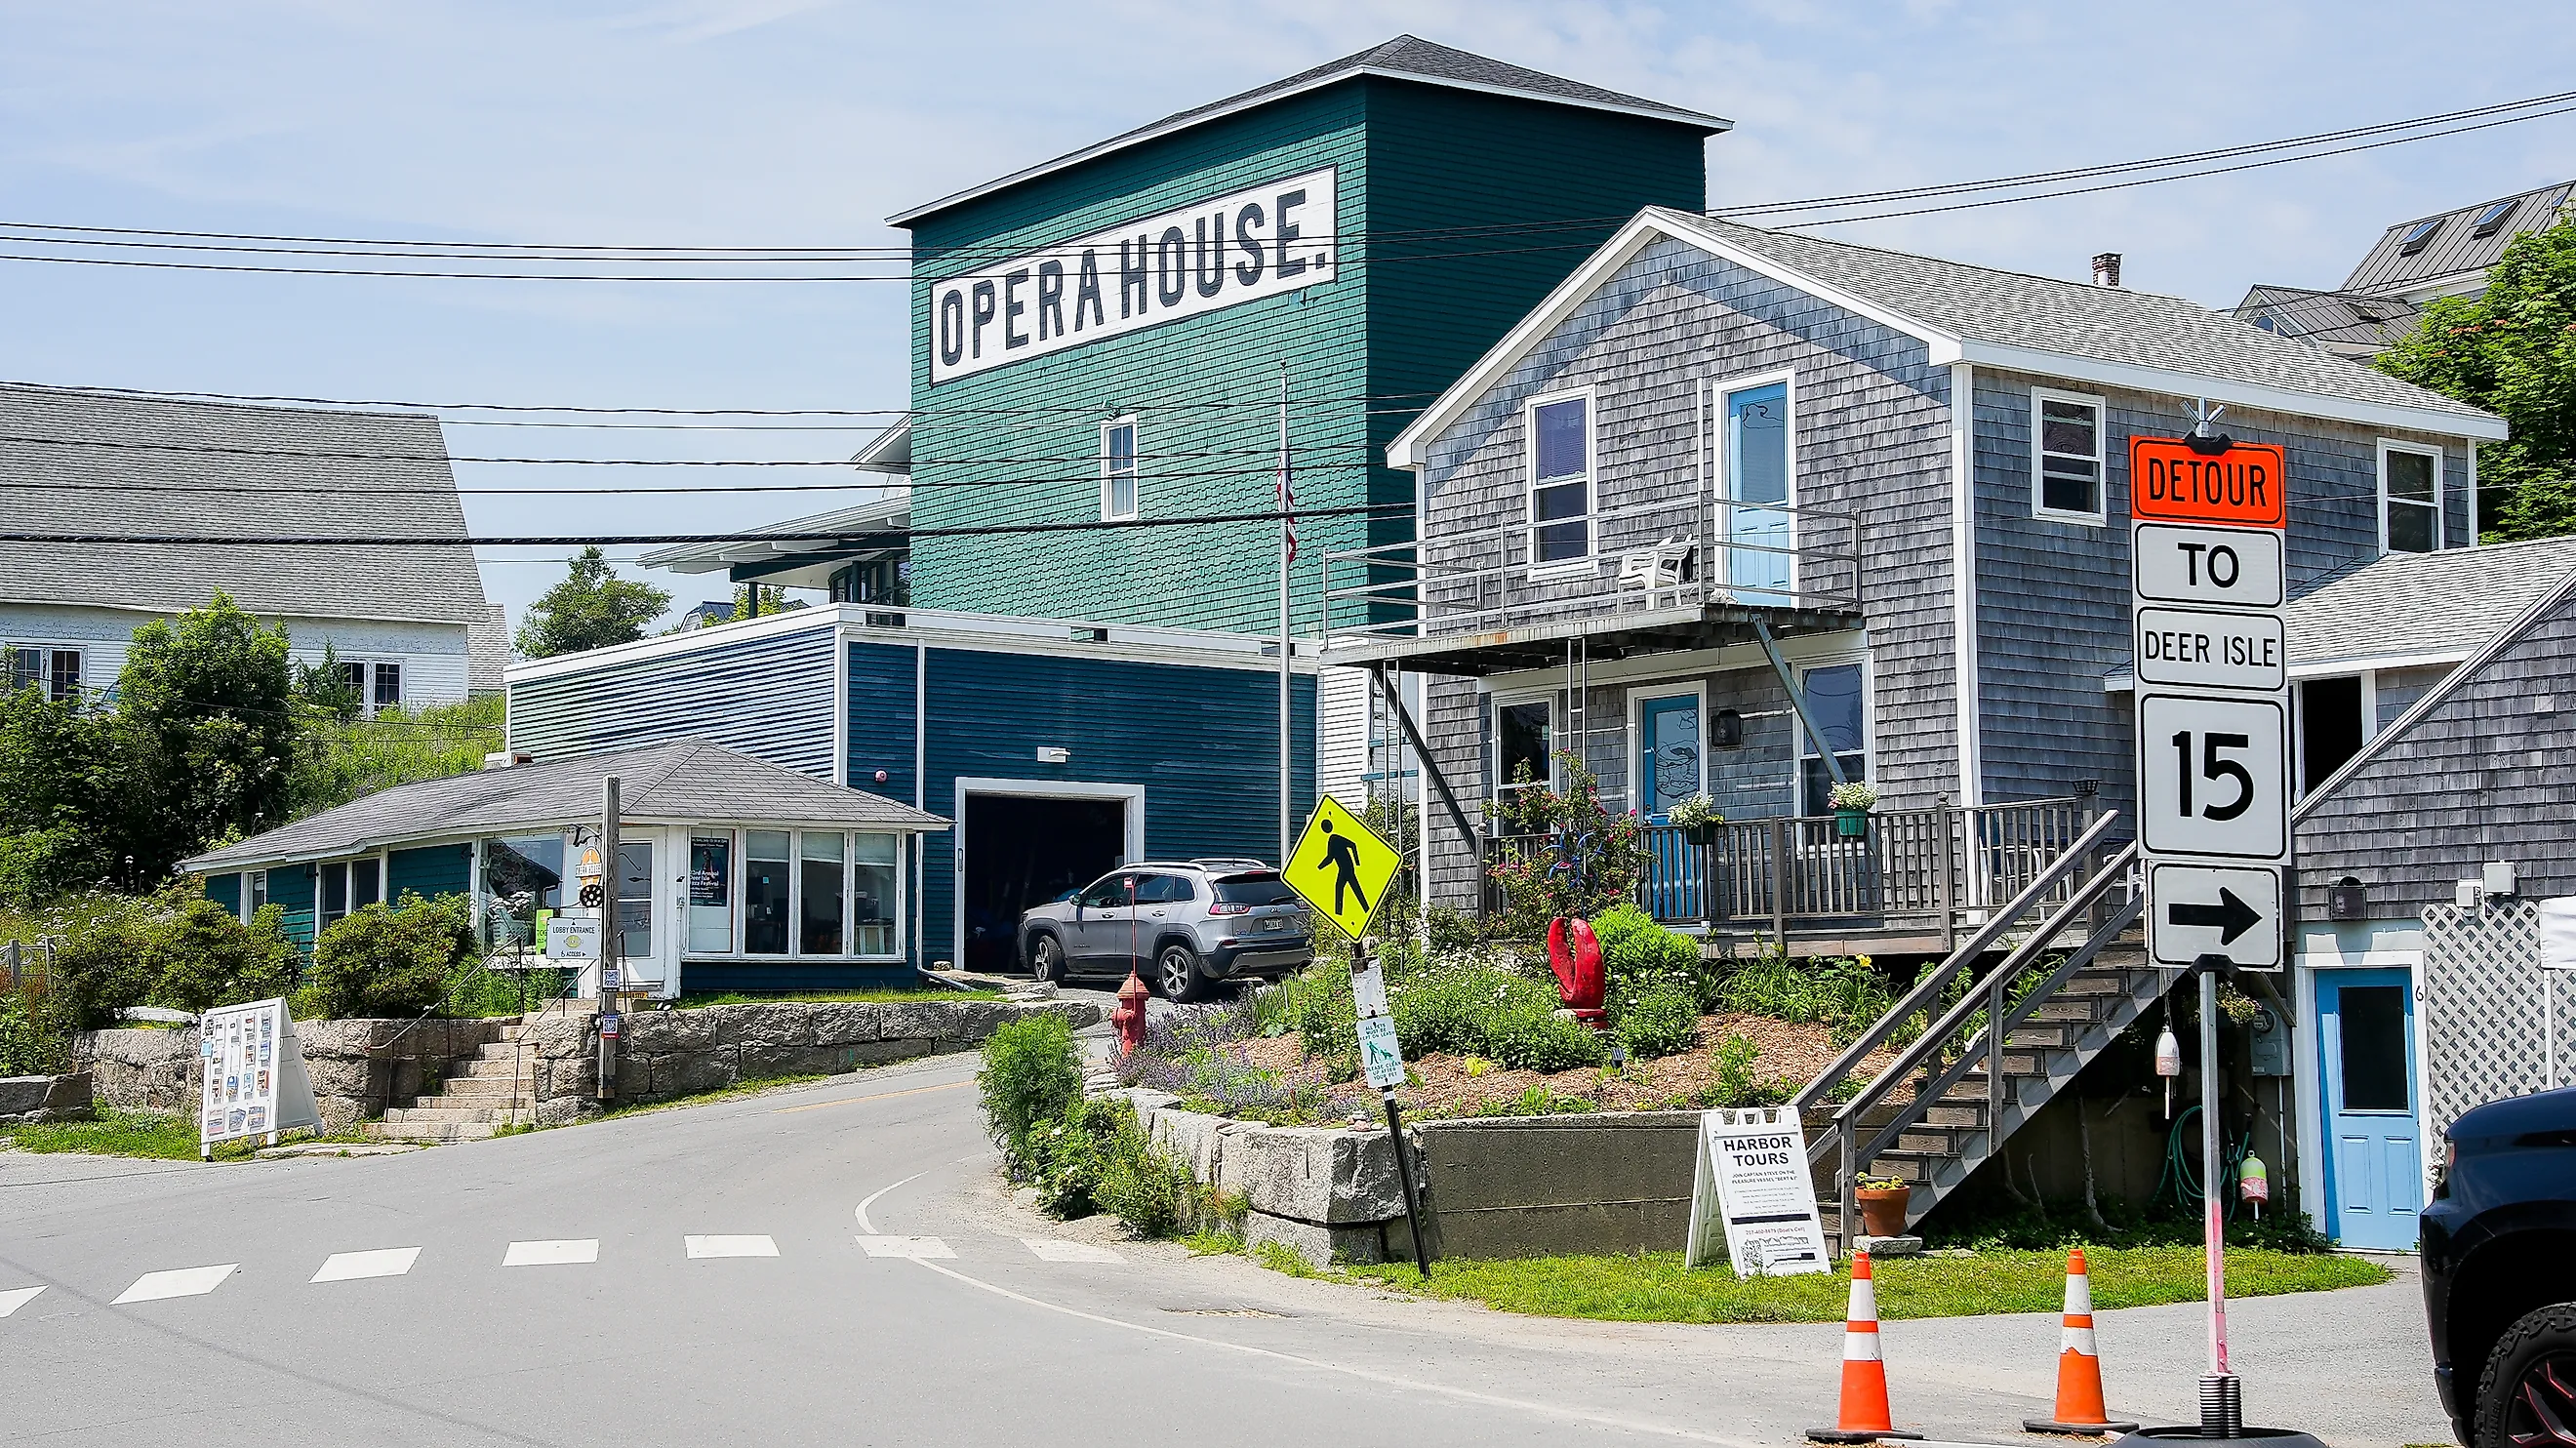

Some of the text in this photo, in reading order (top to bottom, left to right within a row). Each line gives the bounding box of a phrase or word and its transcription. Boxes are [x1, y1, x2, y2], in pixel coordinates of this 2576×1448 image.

[941, 189, 1326, 366] OPERA HOUSE.
[2148, 457, 2267, 507] DETOUR
[2178, 543, 2239, 588] TO
[2145, 630, 2277, 668] DEER ISLE
[2172, 729, 2254, 822] 15
[2415, 985, 2424, 1001] 6
[1723, 1137, 1792, 1151] HARBOR
[1733, 1152, 1789, 1167] TOURS
